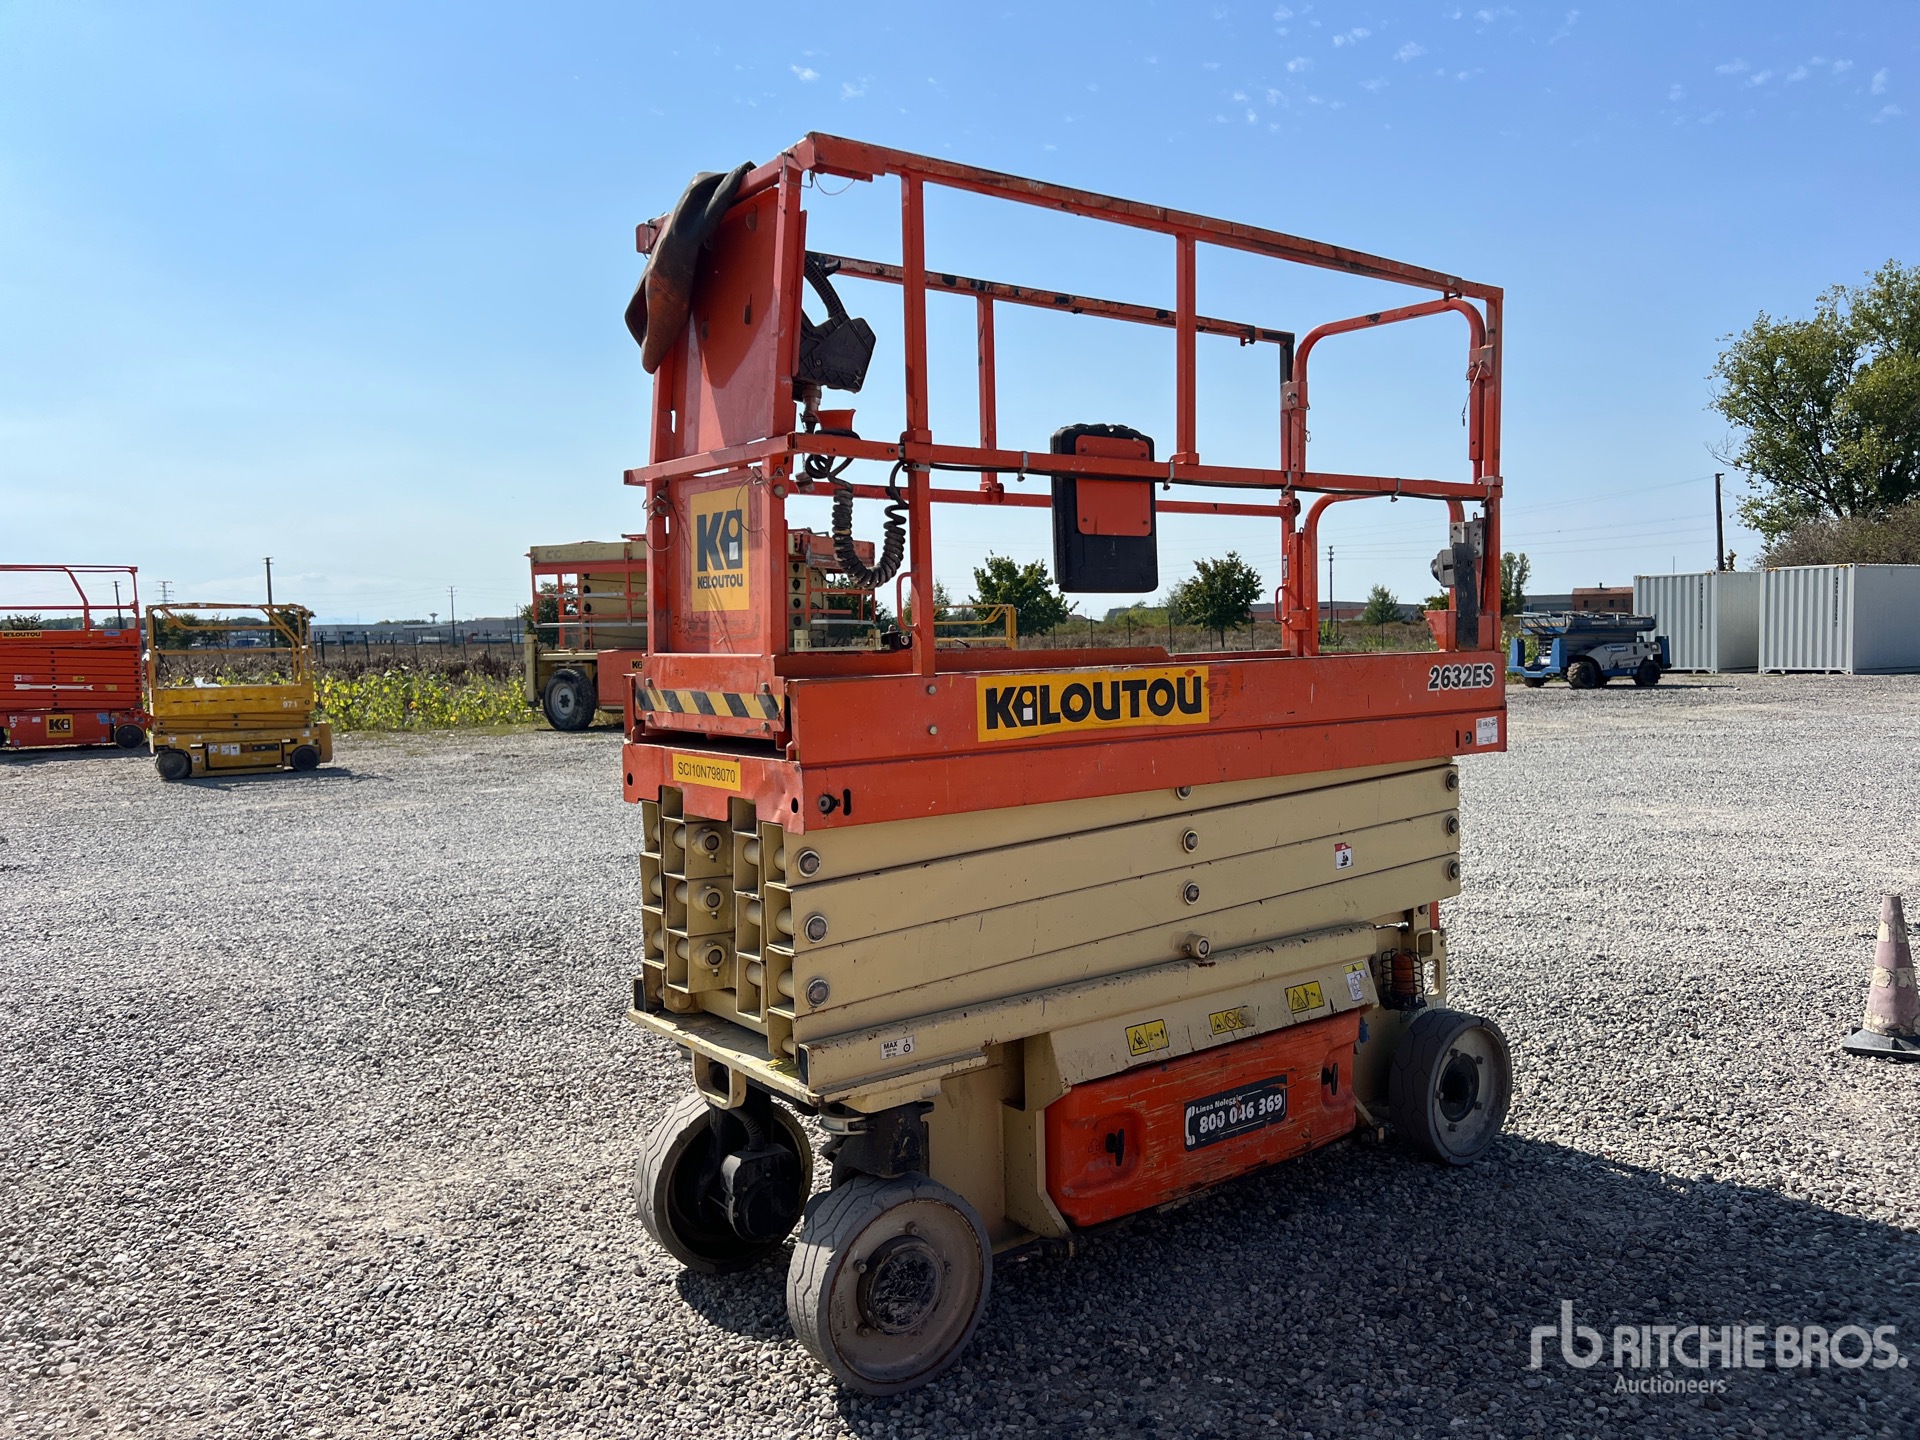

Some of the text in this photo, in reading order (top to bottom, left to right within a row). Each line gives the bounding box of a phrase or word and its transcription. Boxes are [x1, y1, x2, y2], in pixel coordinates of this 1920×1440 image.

[1428, 663, 1495, 691] 2632ES
[883, 1041, 898, 1049] MAX
[1199, 1110, 1226, 1134] 800
[1258, 1093, 1283, 1116] 369
